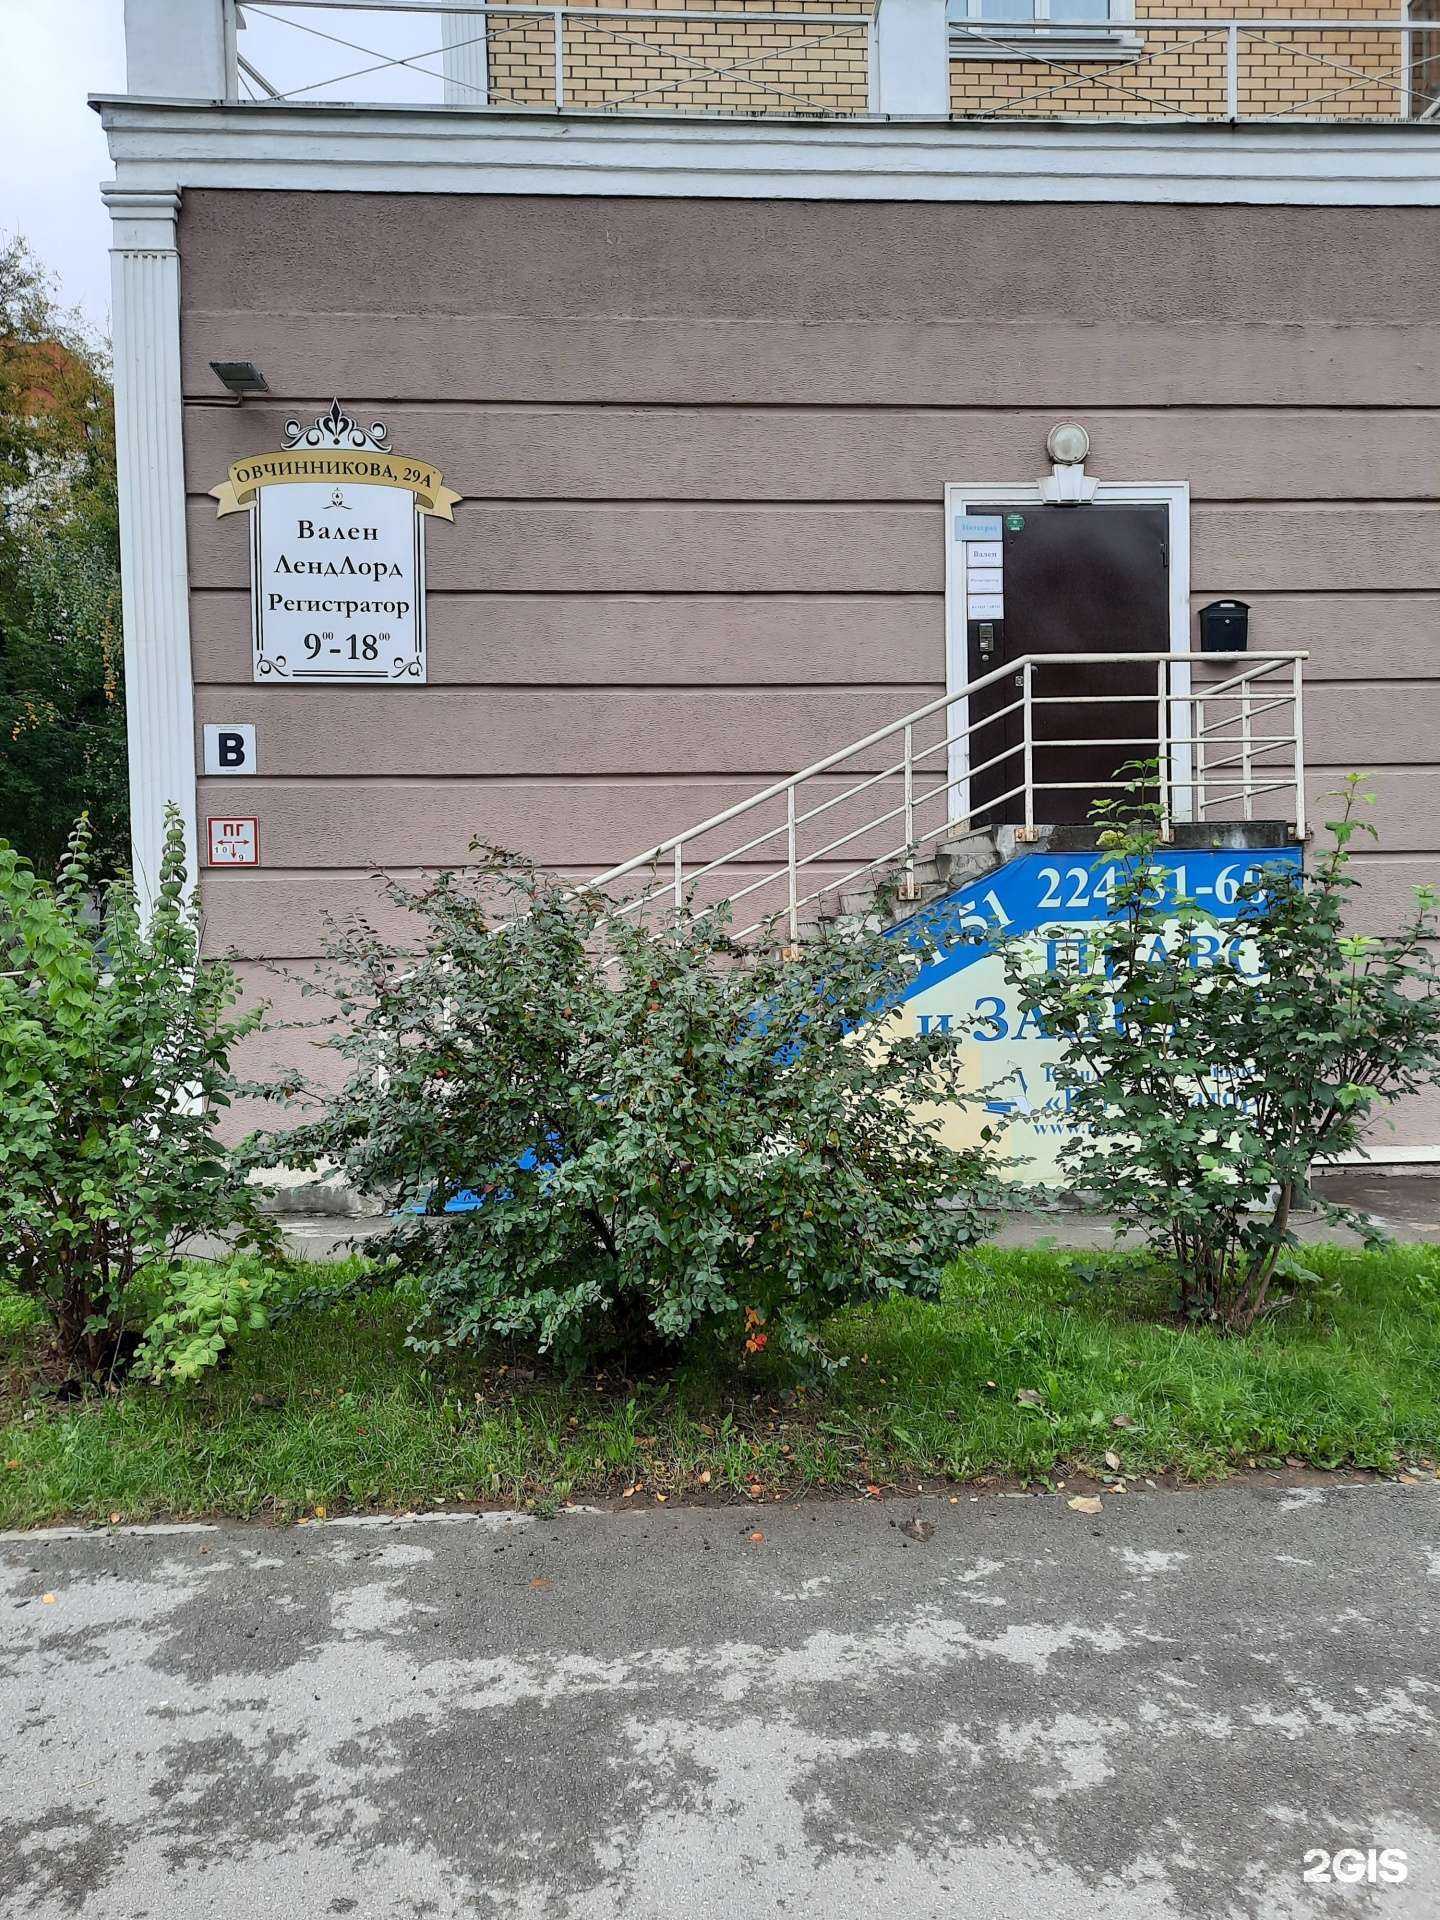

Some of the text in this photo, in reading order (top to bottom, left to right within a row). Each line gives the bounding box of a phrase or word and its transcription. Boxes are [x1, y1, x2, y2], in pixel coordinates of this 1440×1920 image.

[236, 460, 433, 488] ОВЧИННИКОВА, 29А
[297, 520, 379, 541] Вален
[273, 554, 403, 582] ЛендЛорд
[267, 593, 410, 618] Регистратор
[218, 732, 245, 767] В
[223, 823, 244, 837] ПГ
